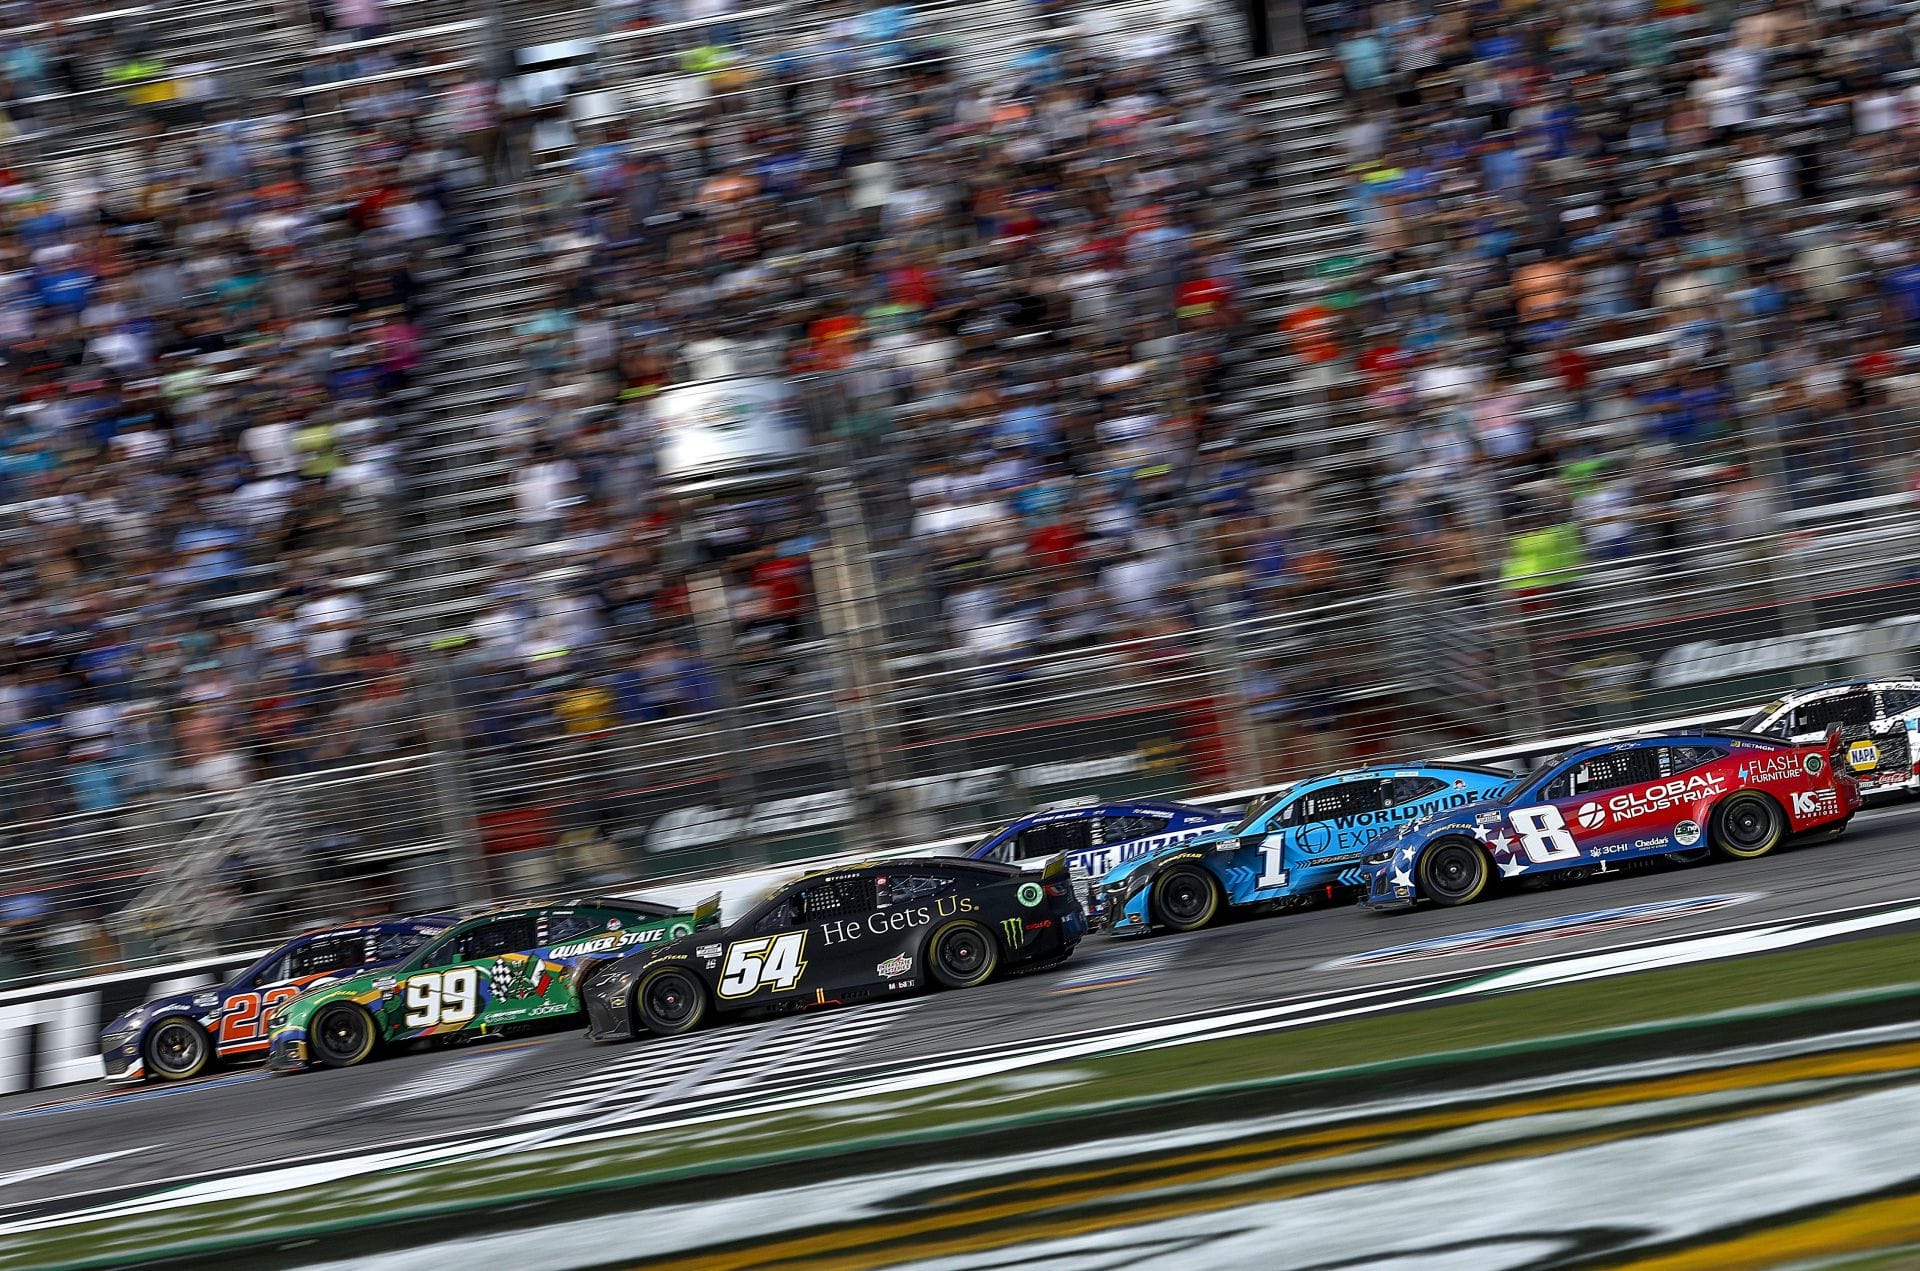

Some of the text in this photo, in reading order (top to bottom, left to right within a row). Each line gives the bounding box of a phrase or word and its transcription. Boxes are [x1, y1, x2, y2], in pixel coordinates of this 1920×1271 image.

[1741, 742, 1775, 752] BETMGM
[1749, 754, 1799, 775] FLASH
[1851, 747, 1877, 764] NAPA
[1609, 772, 1725, 811] GLOBAL
[1751, 769, 1802, 784] FURNITURE
[1334, 790, 1478, 829] WORLDWIDE
[1612, 784, 1727, 822] INDUSTRIAL
[1508, 805, 1580, 864] 8
[1602, 843, 1628, 855] 3CHI
[1253, 831, 1290, 892] 1
[820, 895, 980, 945] He Gets Us.
[549, 928, 666, 960] QUAKER STATE
[717, 929, 808, 999] 54
[218, 986, 300, 1043] 22
[405, 966, 479, 1029] 99
[528, 1003, 568, 1016] JOCKEY
